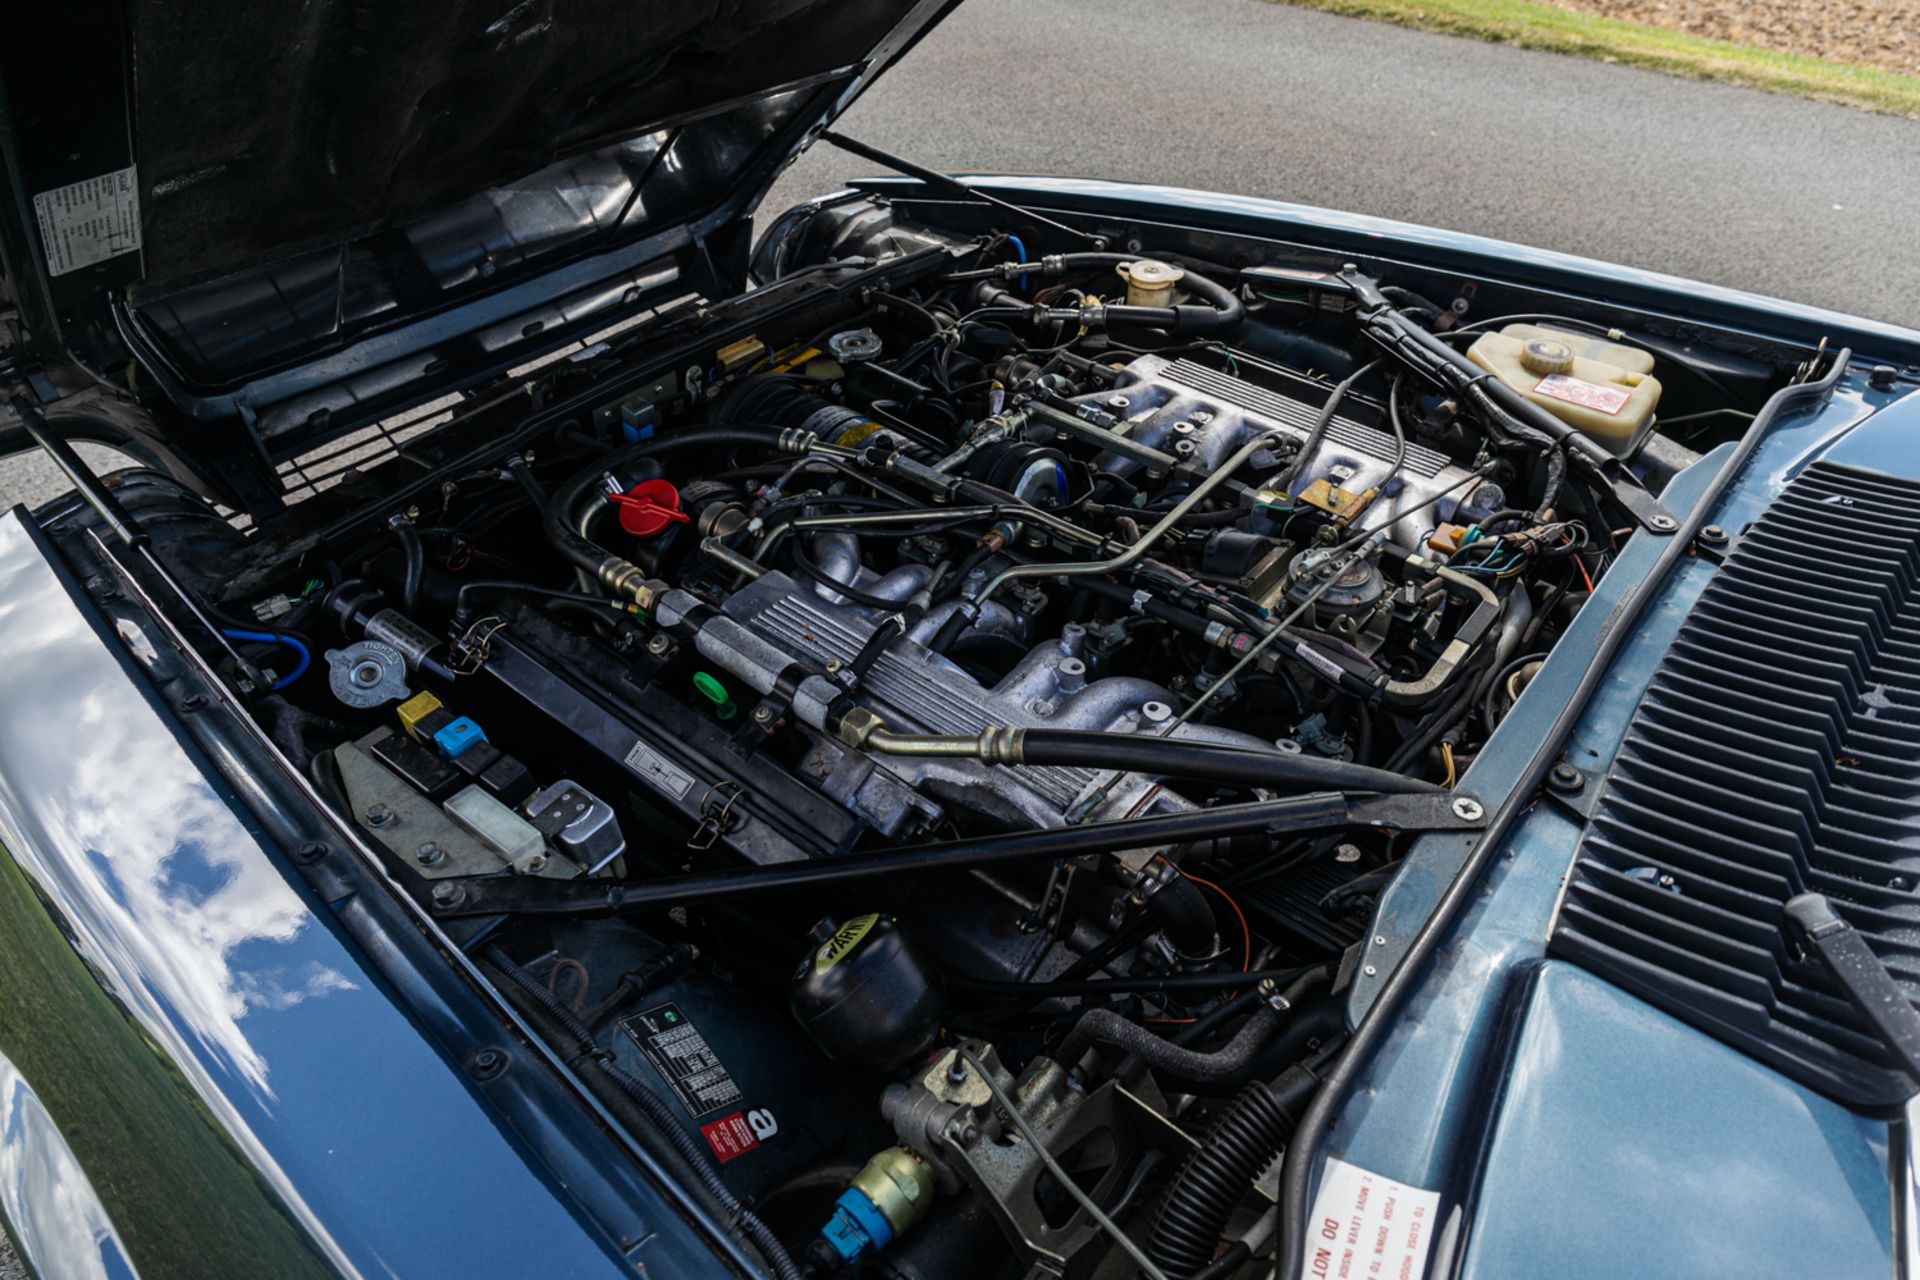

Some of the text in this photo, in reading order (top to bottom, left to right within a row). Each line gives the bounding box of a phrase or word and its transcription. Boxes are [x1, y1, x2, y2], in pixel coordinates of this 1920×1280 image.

[364, 641, 401, 664] TIGHTEN
[748, 1108, 778, 1142] a
[1355, 1187, 1370, 1212] MOVE
[1383, 1196, 1396, 1221] PUSH
[1413, 1206, 1425, 1218] TO
[1346, 1215, 1362, 1245] LEVER
[1374, 1225, 1389, 1255] DOWN
[1406, 1221, 1421, 1249] CLOSE
[1311, 1217, 1339, 1280] DO NOT
[1338, 1248, 1353, 1279] INSIDE
[1369, 1260, 1381, 1273] TO
